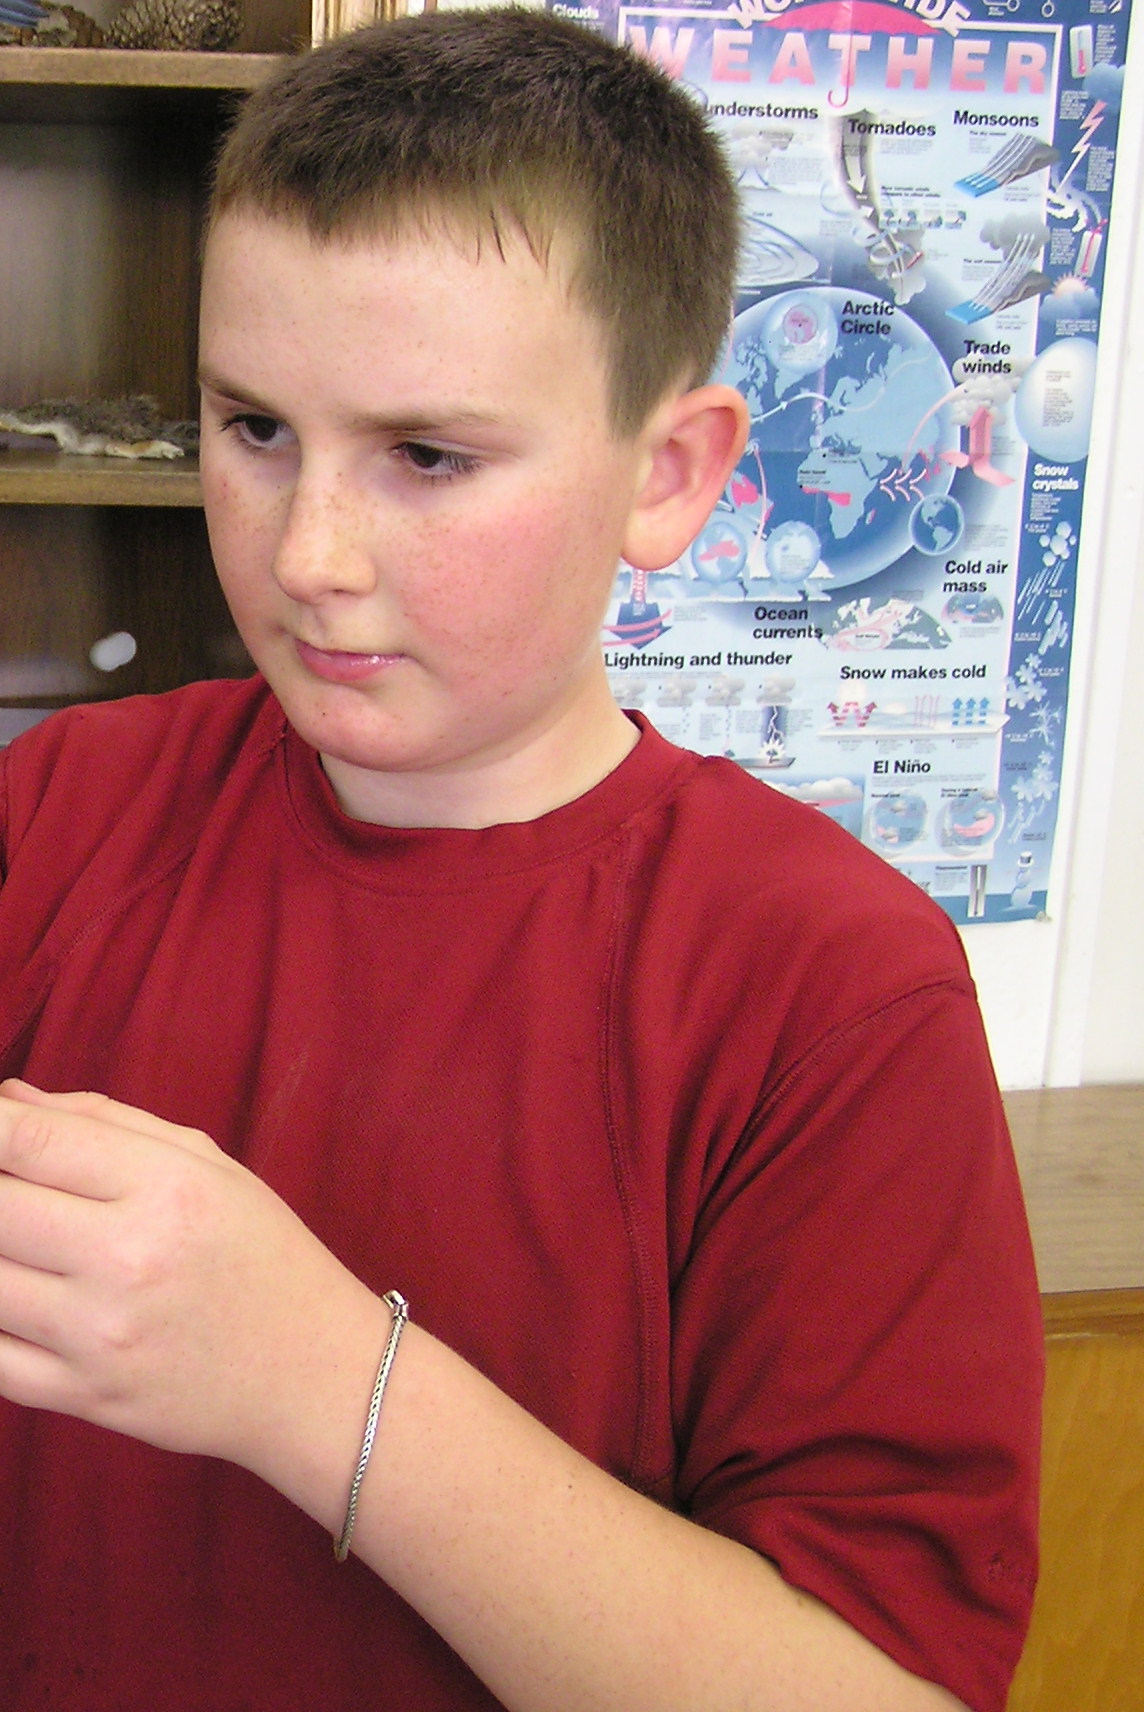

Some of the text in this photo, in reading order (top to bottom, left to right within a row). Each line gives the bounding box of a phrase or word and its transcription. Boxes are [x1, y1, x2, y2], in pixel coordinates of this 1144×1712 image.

[553, 3, 599, 20] Clouds
[629, 25, 1047, 94] WEATHER
[709, 101, 819, 119] understorms
[953, 110, 1039, 127] Monsoons
[848, 119, 937, 136] Tornadoes
[842, 300, 895, 316] Arctic
[841, 319, 891, 335] Circle
[963, 340, 1011, 355] Trade
[962, 359, 1012, 374] winds
[1033, 463, 1069, 476] Snow
[1032, 477, 1079, 492] crystals
[945, 559, 1008, 574] Cold air
[943, 580, 987, 593] mass
[754, 606, 808, 621] Ocean
[753, 624, 823, 639] currents
[605, 651, 792, 669] Lightning and thunder
[840, 664, 986, 679] Snow makes cold
[873, 759, 931, 774] El Niño
